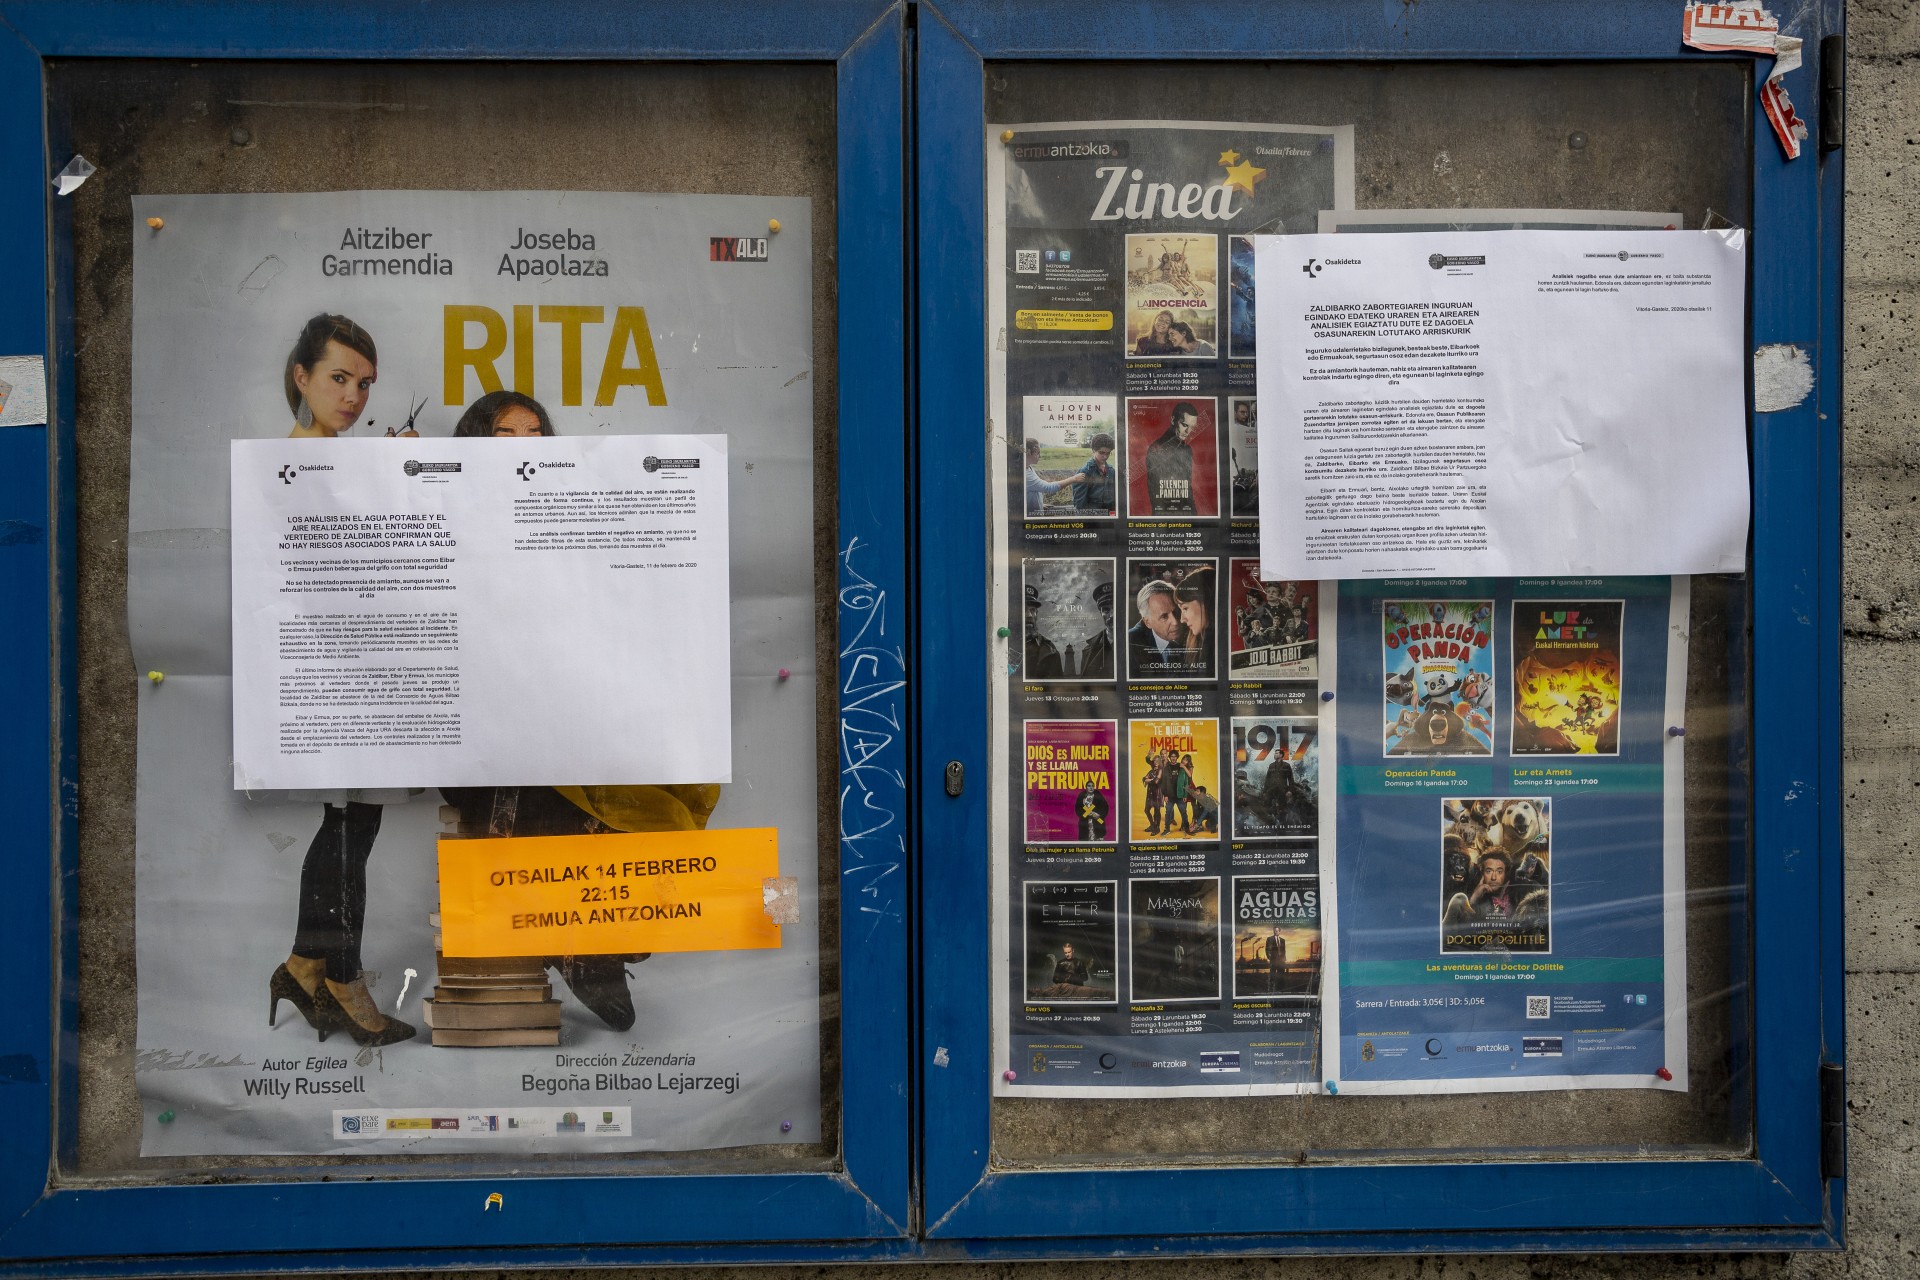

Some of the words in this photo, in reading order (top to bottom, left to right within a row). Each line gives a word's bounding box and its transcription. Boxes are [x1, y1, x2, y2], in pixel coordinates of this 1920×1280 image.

[1015, 143, 1110, 158] ermuantzokia
[1091, 166, 1243, 220] Zinea
[340, 228, 432, 250] Aitziber
[510, 228, 595, 250] Joseba
[322, 253, 453, 276] Garmendia
[498, 254, 609, 281] Apaolaza
[1149, 299, 1207, 307] INOCENCIA
[1310, 304, 1361, 312] ZALDIBARKO
[1305, 313, 1346, 321] EGINDAKO
[1348, 312, 1385, 320] EDATEKO
[1311, 321, 1352, 329] ANALISIEK
[1354, 320, 1398, 328] EGIAZTATU
[1314, 330, 1376, 338] OSASUNAREKIN
[443, 305, 668, 406] RITA
[1062, 404, 1101, 412] JOVEN
[304, 514, 338, 522] ANÁLISIS
[1386, 623, 1490, 650] OPERACIÓN
[1249, 651, 1268, 665] JOJO
[1270, 646, 1302, 663] RABBIT
[1407, 642, 1471, 663] PANDA
[1153, 725, 1163, 736] TE
[1151, 734, 1197, 752] IMBÉCIL
[1233, 725, 1317, 762] 1917
[1028, 746, 1053, 760] DIOS
[1057, 749, 1067, 760] ES
[1070, 746, 1109, 760] MUJER
[1028, 762, 1035, 770] Y
[1037, 762, 1048, 770] SE
[1050, 762, 1078, 771] LLAMA
[1385, 769, 1428, 778] Operación
[1431, 769, 1456, 777] Panda
[1546, 768, 1572, 776] Amets
[1028, 771, 1110, 789] PETRUNYA
[490, 865, 590, 887] OTSAILAK
[596, 863, 617, 878] 14
[622, 857, 717, 878] FEBRERO
[581, 886, 630, 902] 22:15
[1240, 891, 1317, 907] AGUAS
[1042, 905, 1099, 916] ETER
[1148, 897, 1203, 910] MALASAÑA
[512, 912, 582, 930] ERMUA
[589, 902, 702, 923] ANTZOKIAN
[1170, 908, 1181, 918] 32
[1240, 907, 1317, 918] OSCURAS
[1447, 935, 1492, 944] DOCTOR
[1499, 935, 1545, 944] DOLITTLE
[1356, 1000, 1382, 1008] Sarrera
[1390, 999, 1420, 1008] Entrada:
[1422, 998, 1444, 1008] 3,05€
[1450, 998, 1462, 1006] 3D:
[1464, 998, 1485, 1006] 5,05€
[262, 1059, 300, 1071] Autor
[306, 1057, 347, 1072] Egilea
[556, 1054, 617, 1067] Dirección
[622, 1053, 696, 1067] Zuzendaria
[244, 1079, 291, 1099] Willy
[295, 1076, 365, 1094] Russell
[522, 1074, 590, 1095] Begoña
[596, 1074, 652, 1090] Bilbao
[658, 1073, 740, 1094] Lejarzegi
